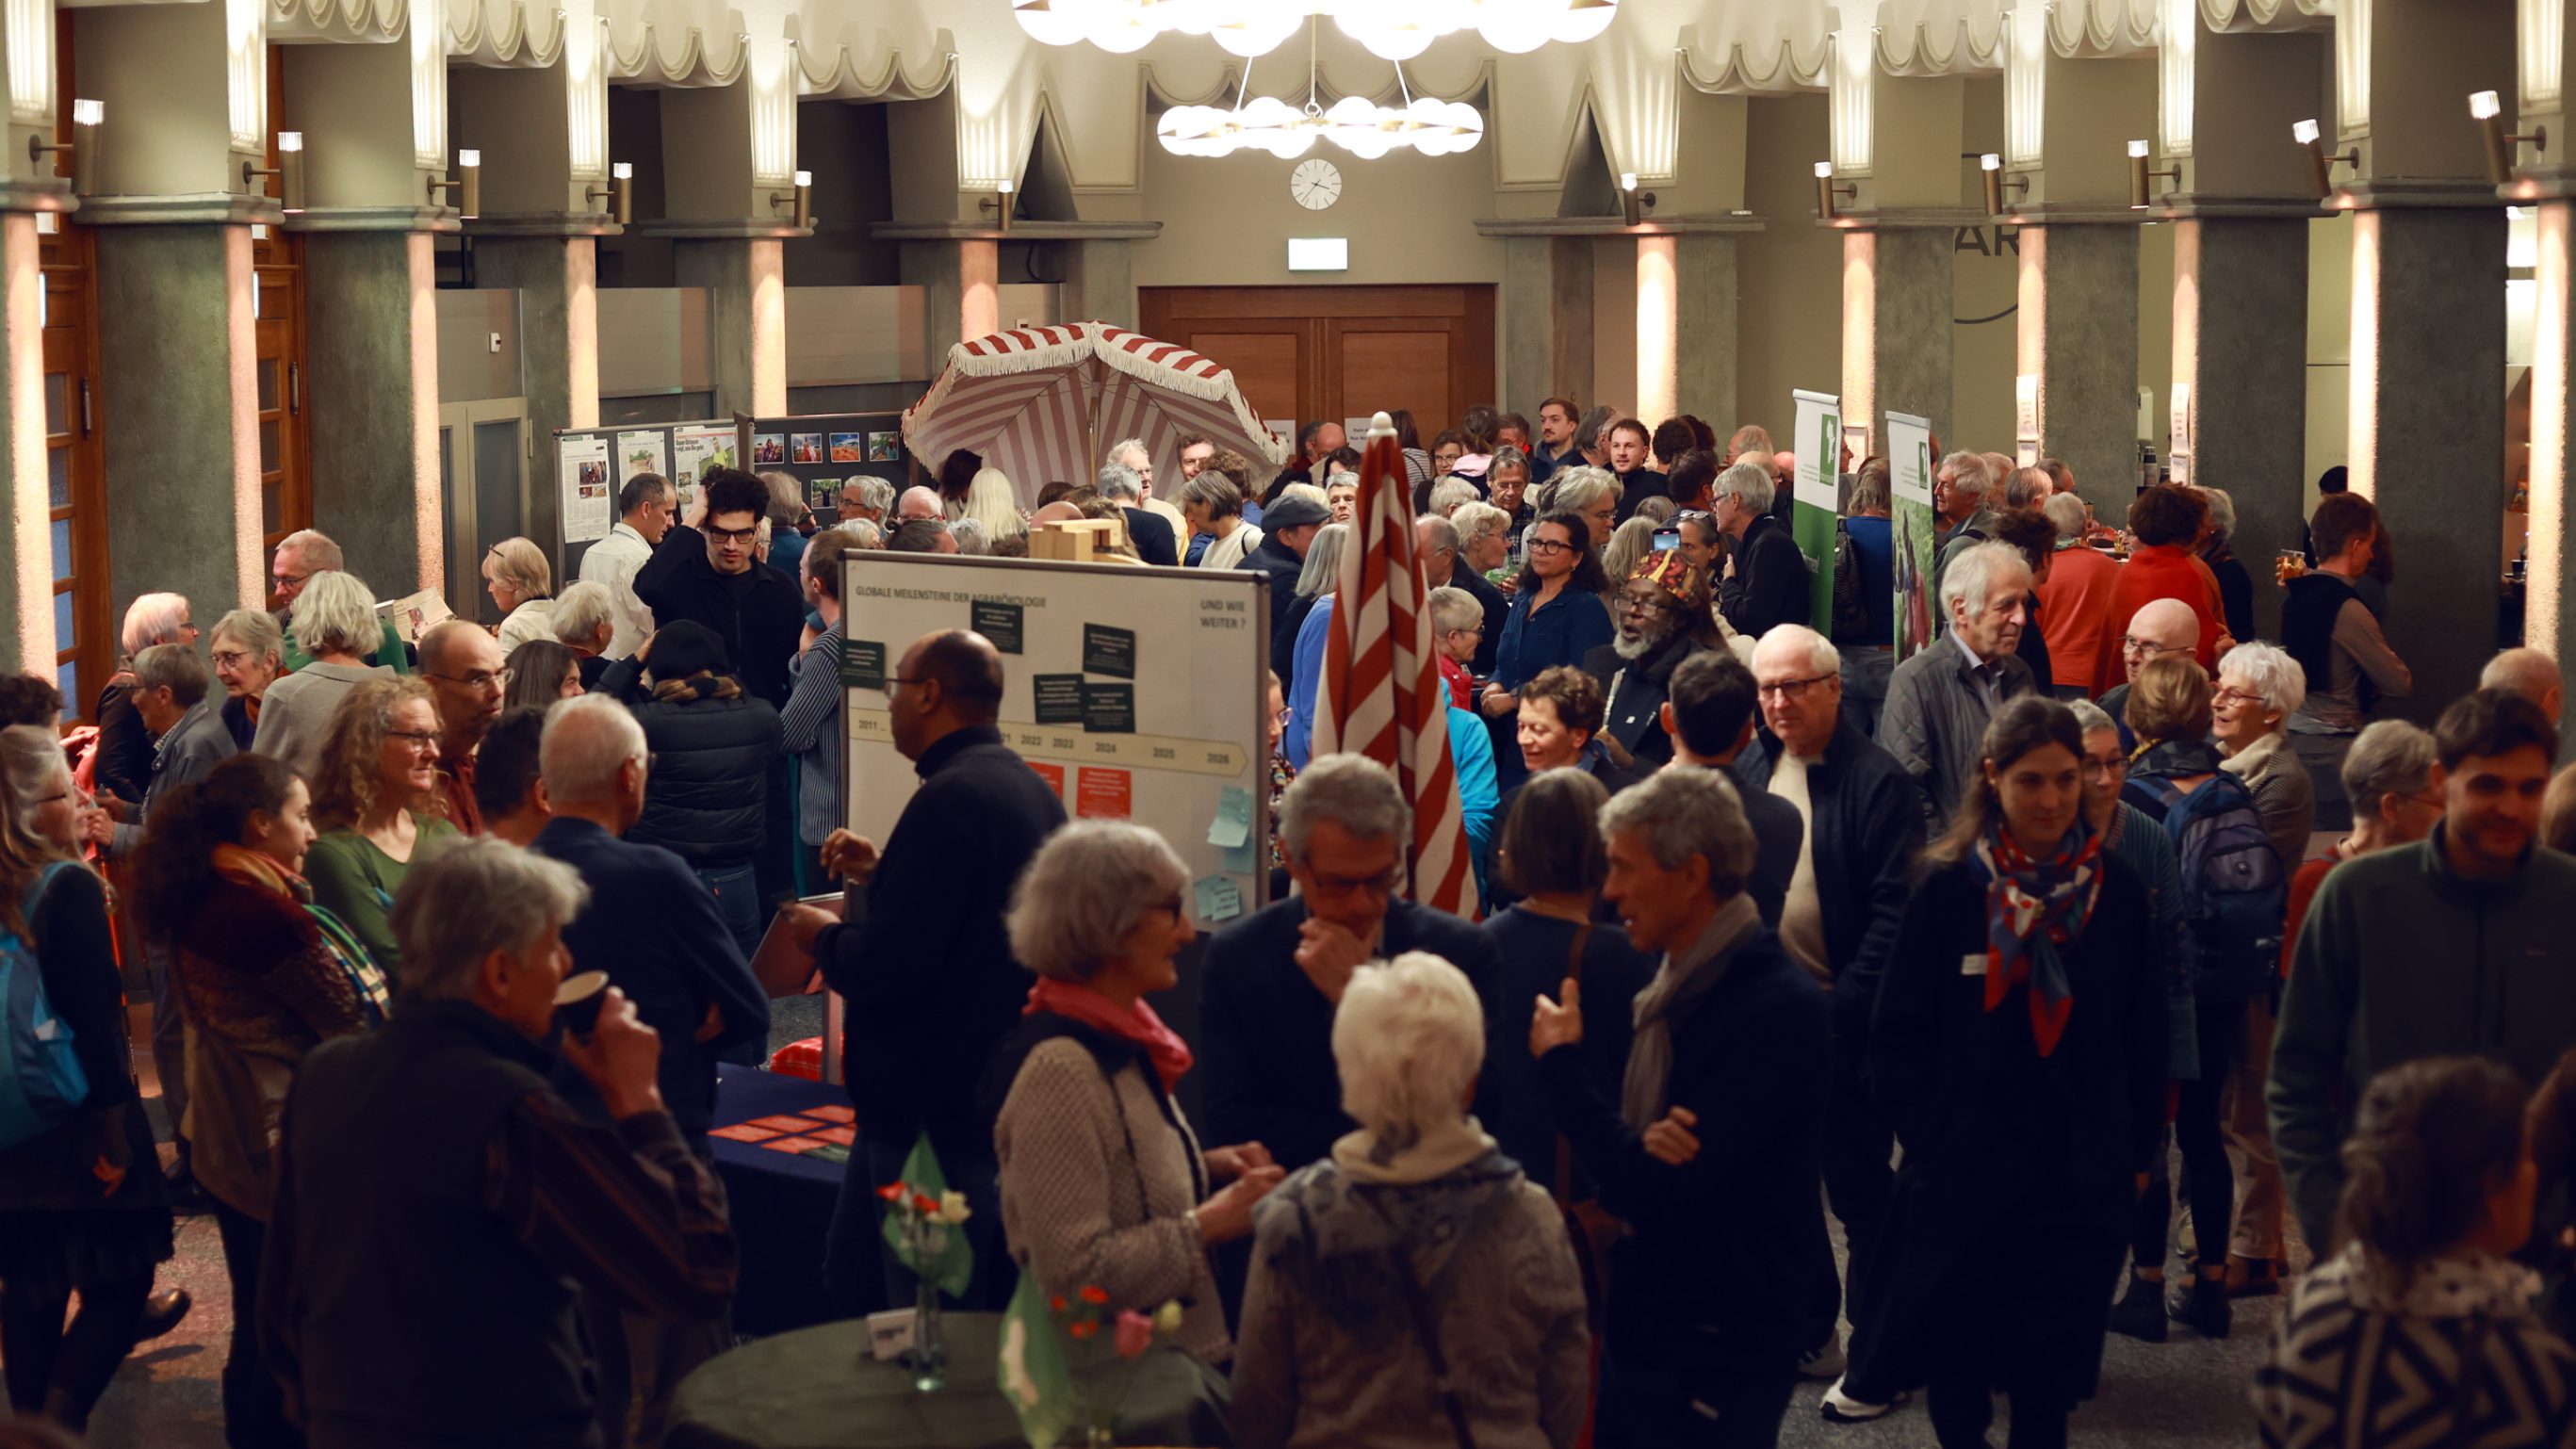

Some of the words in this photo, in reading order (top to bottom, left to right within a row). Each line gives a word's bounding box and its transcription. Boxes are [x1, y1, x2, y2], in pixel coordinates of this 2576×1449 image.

[856, 586, 891, 598] GLOBALE
[893, 589, 952, 603] MEILENSTEINE
[953, 592, 970, 603] DER
[972, 594, 1046, 608] AGRARÖKOLOGIE
[1200, 599, 1224, 611] UND
[1225, 600, 1245, 612] WIE
[1200, 617, 1237, 629] WEITER
[858, 720, 878, 731] 2011
[1020, 734, 1042, 747] 2022
[1052, 738, 1074, 750] 2023
[1095, 741, 1117, 755] 2024
[1152, 747, 1175, 759] 2025
[1207, 753, 1231, 765] 2026
